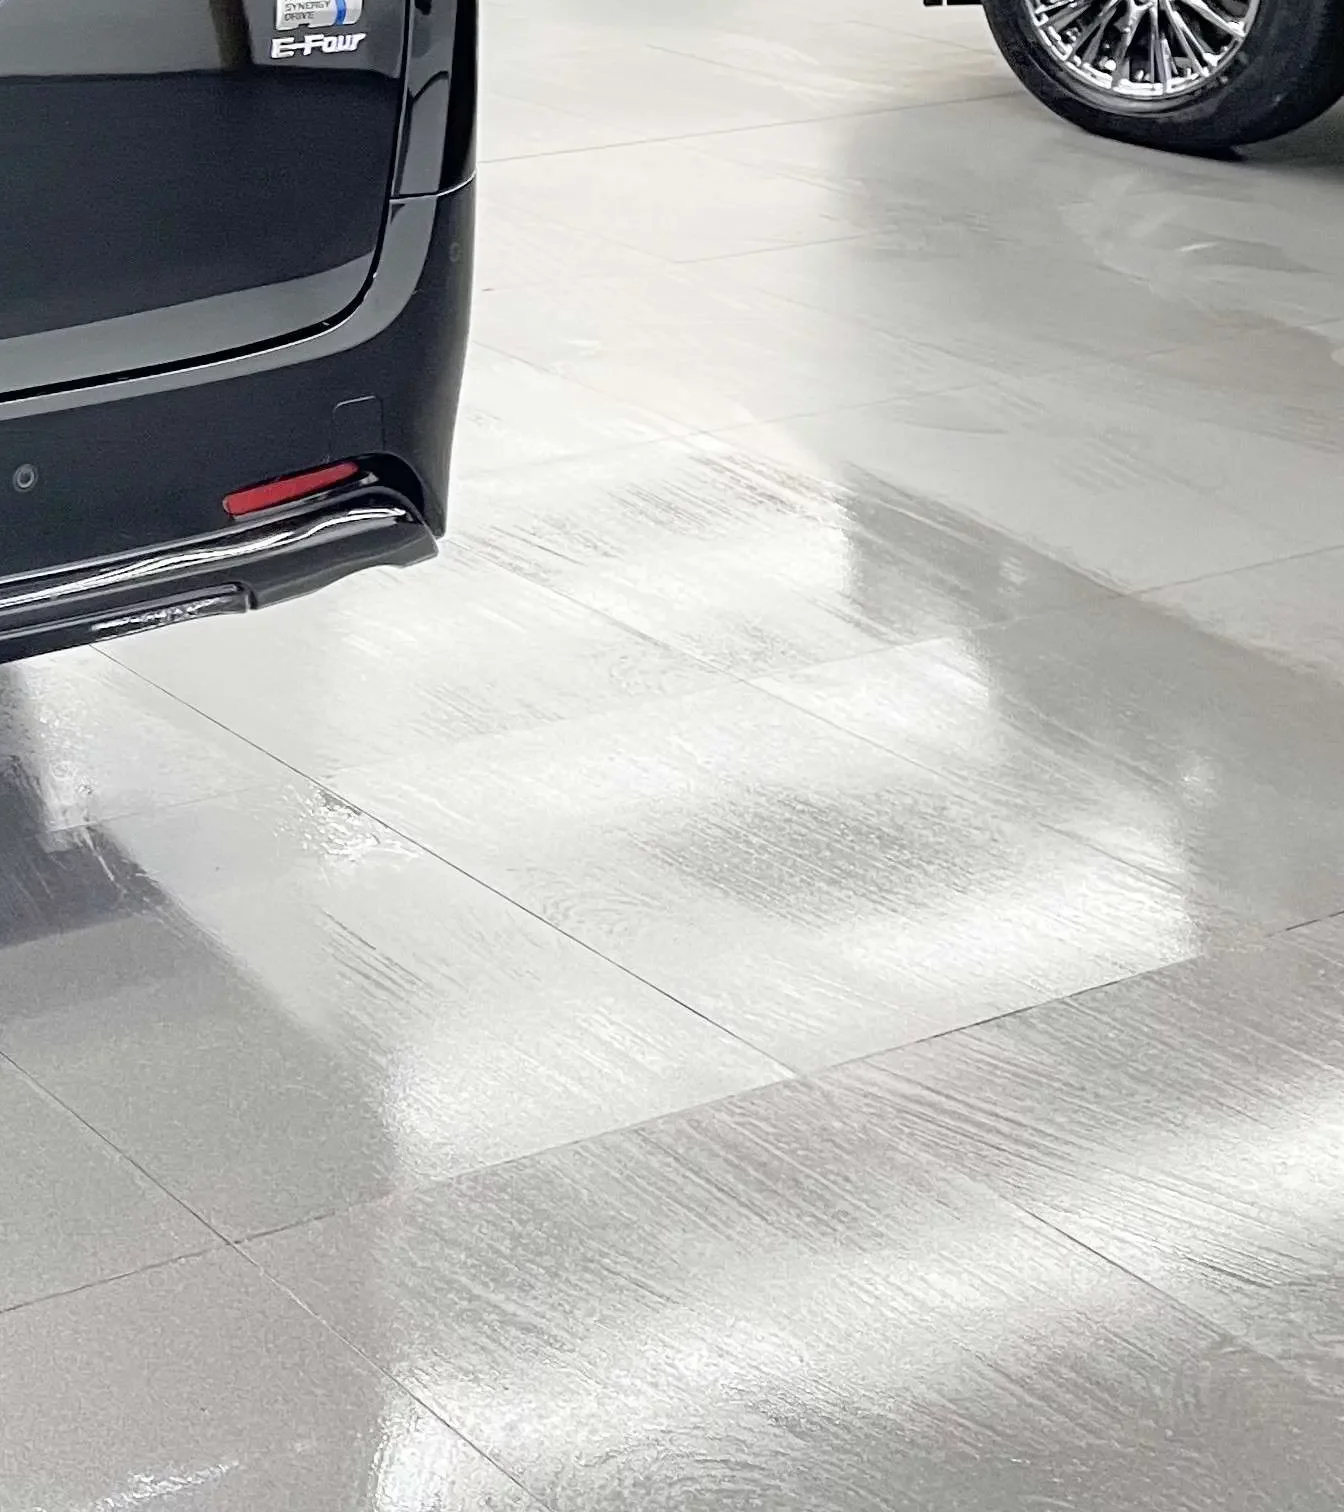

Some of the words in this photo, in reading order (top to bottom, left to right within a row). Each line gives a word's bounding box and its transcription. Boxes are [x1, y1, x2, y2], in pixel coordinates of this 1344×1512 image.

[284, 0, 331, 12] SYNERGY
[284, 11, 315, 22] DRIVE
[271, 33, 367, 59] E-Four
